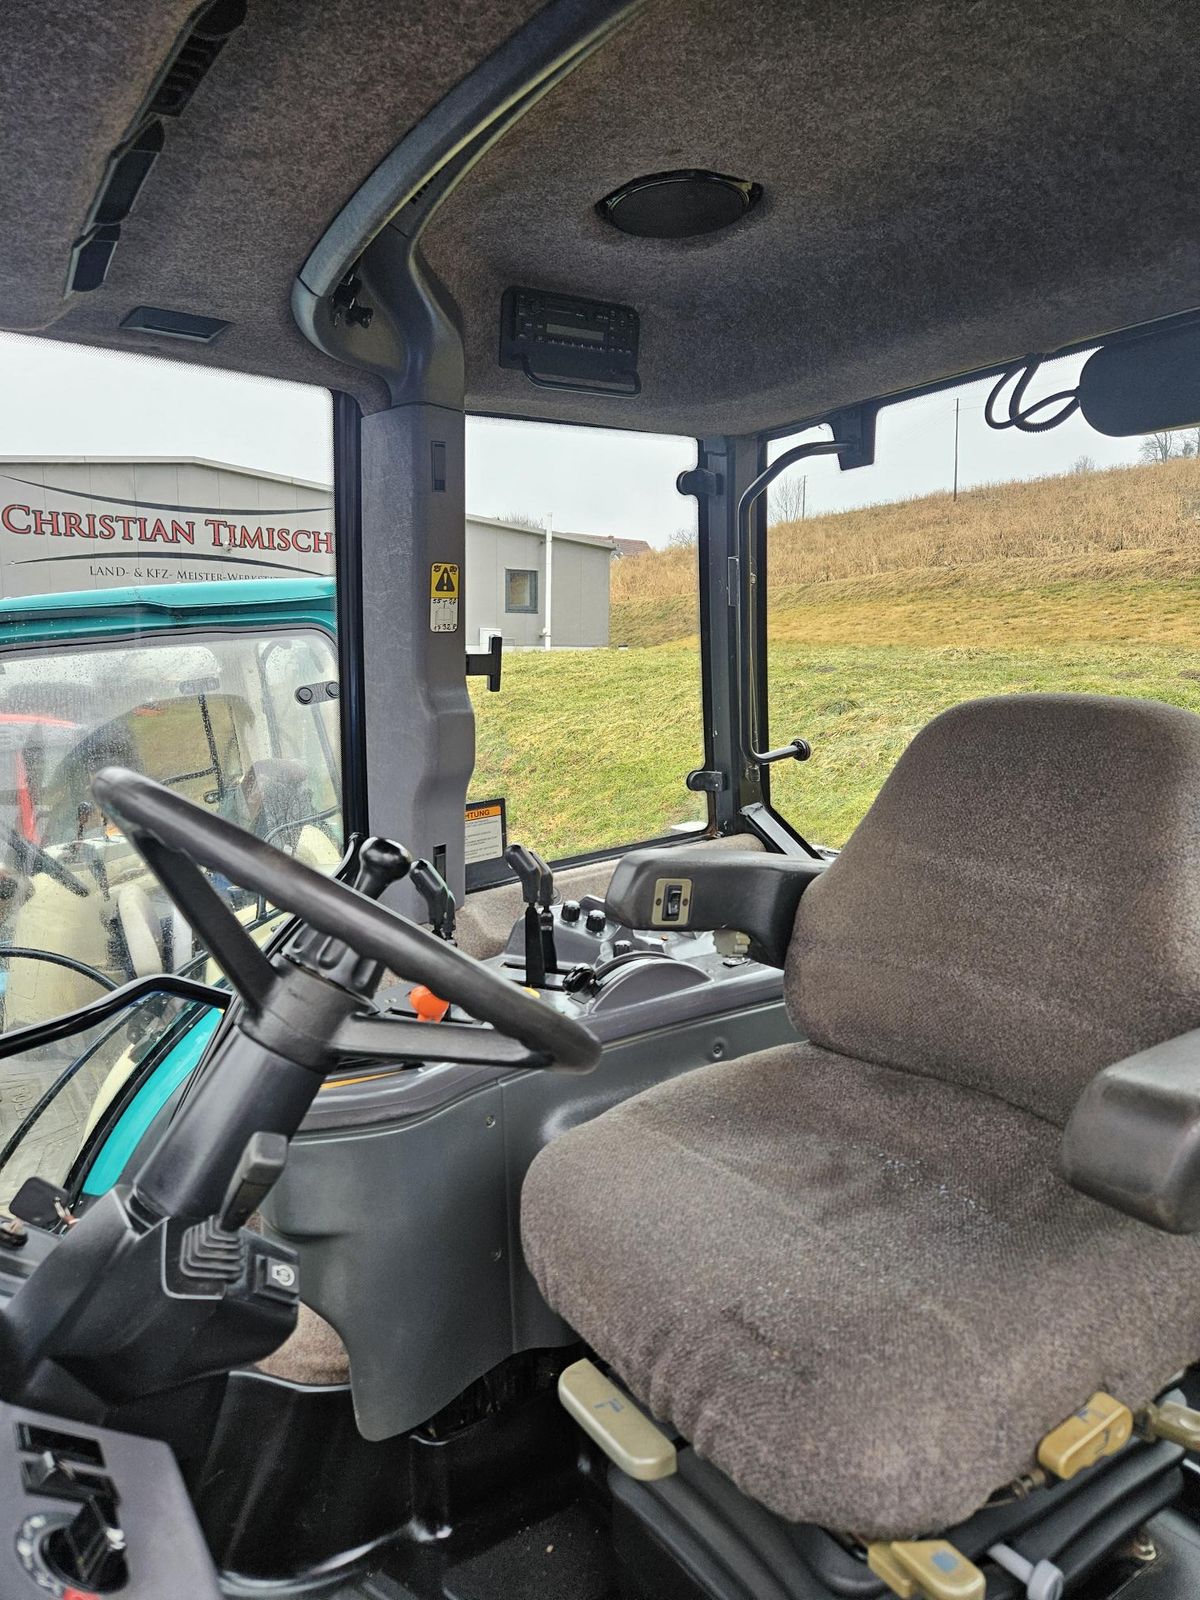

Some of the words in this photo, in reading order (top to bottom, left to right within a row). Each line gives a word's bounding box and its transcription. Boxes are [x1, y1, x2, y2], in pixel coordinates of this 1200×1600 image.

[1, 503, 195, 545] CHRISTIAN
[204, 518, 335, 554] TIMISCH
[89, 565, 130, 577] LAND-
[134, 567, 143, 578] &
[146, 568, 172, 579] KFZ-
